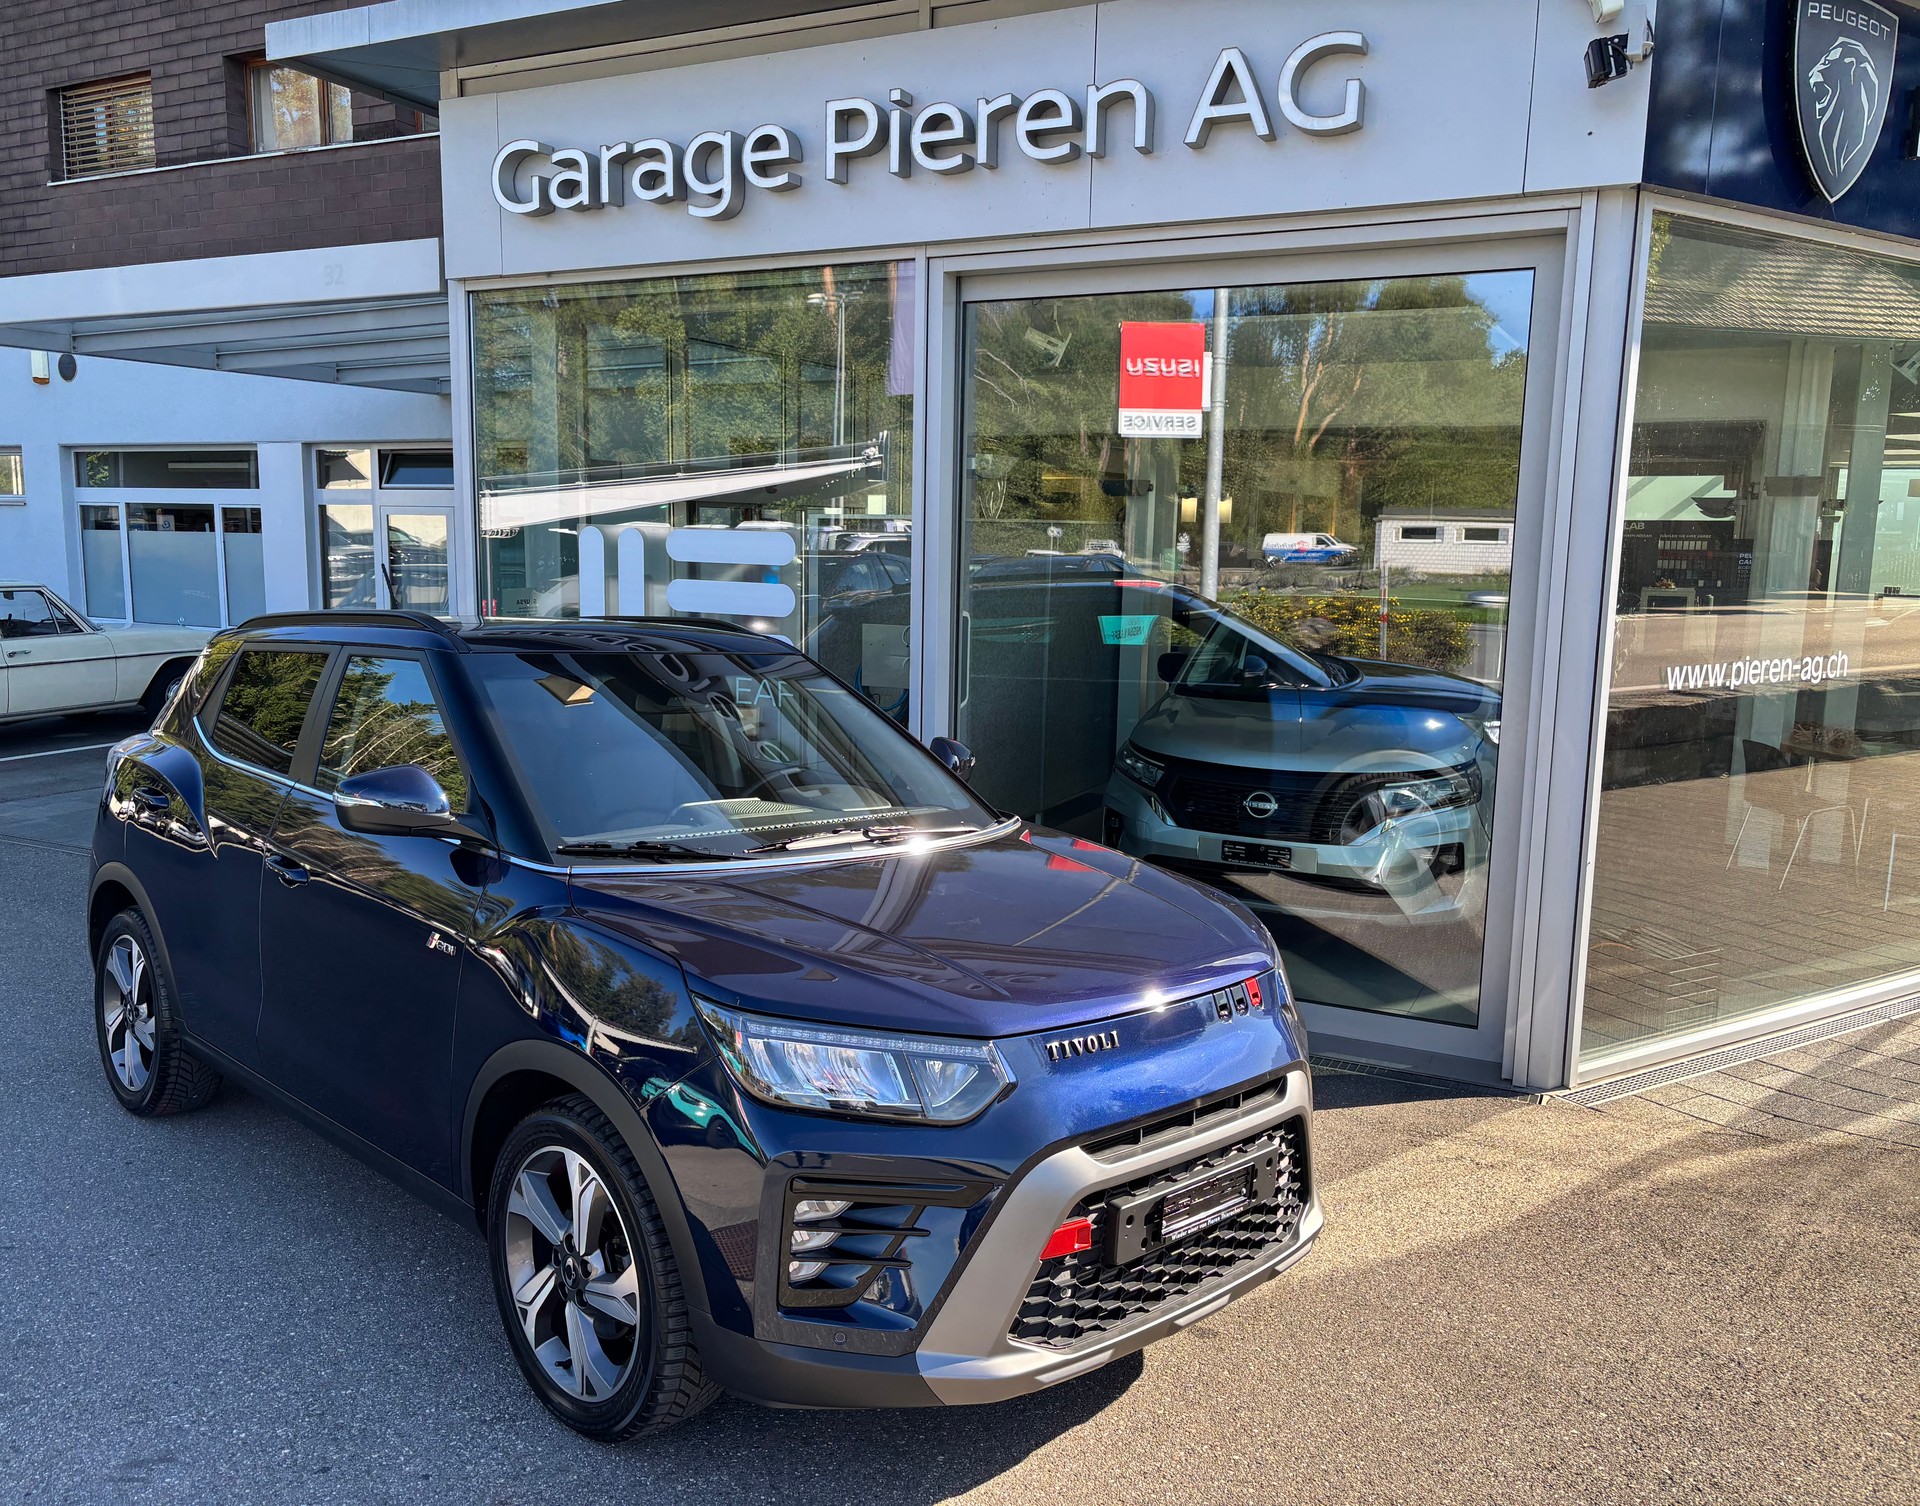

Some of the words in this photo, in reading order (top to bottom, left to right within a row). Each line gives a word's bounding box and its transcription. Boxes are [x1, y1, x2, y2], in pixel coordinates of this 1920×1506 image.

[1807, 2, 1891, 41] PEUGEOT
[491, 123, 802, 221] Garage
[825, 87, 1156, 184] Pieren
[1183, 30, 1370, 150] AG
[1667, 650, 1849, 691] www.pieren-ag.ch
[1243, 800, 1279, 810] NISSAN
[1045, 1030, 1120, 1062] TIVOLI
